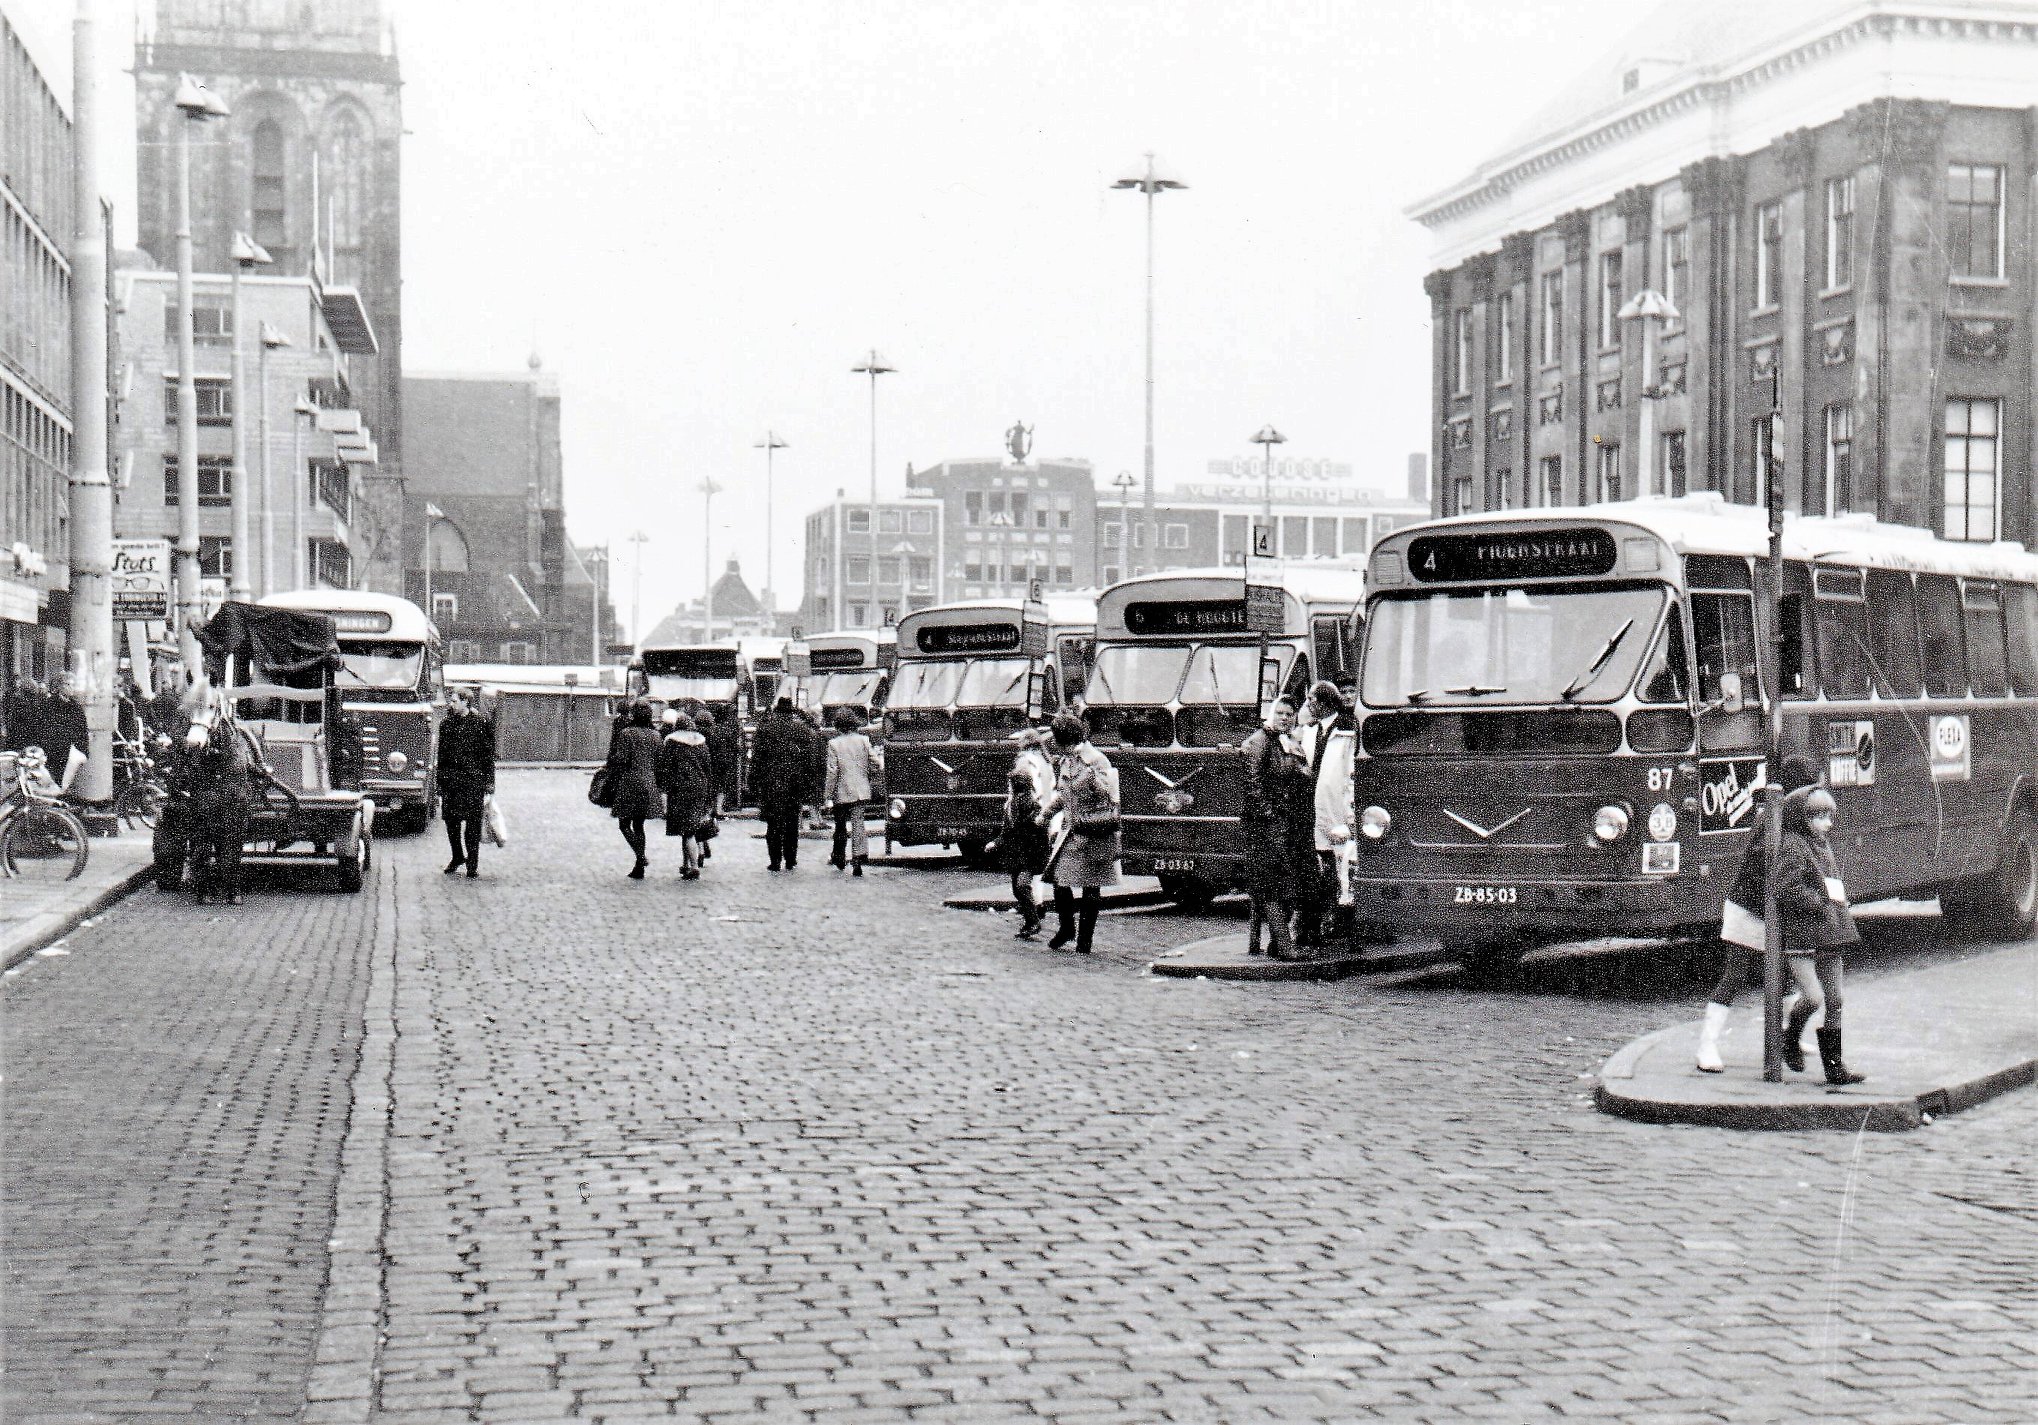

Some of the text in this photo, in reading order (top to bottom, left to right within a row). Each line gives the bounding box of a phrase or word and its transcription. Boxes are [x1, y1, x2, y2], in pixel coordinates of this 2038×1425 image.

[1259, 534, 1268, 550] 4
[1423, 550, 1437, 571] 4
[1647, 768, 1673, 791] 87
[1702, 763, 1739, 816] Opel
